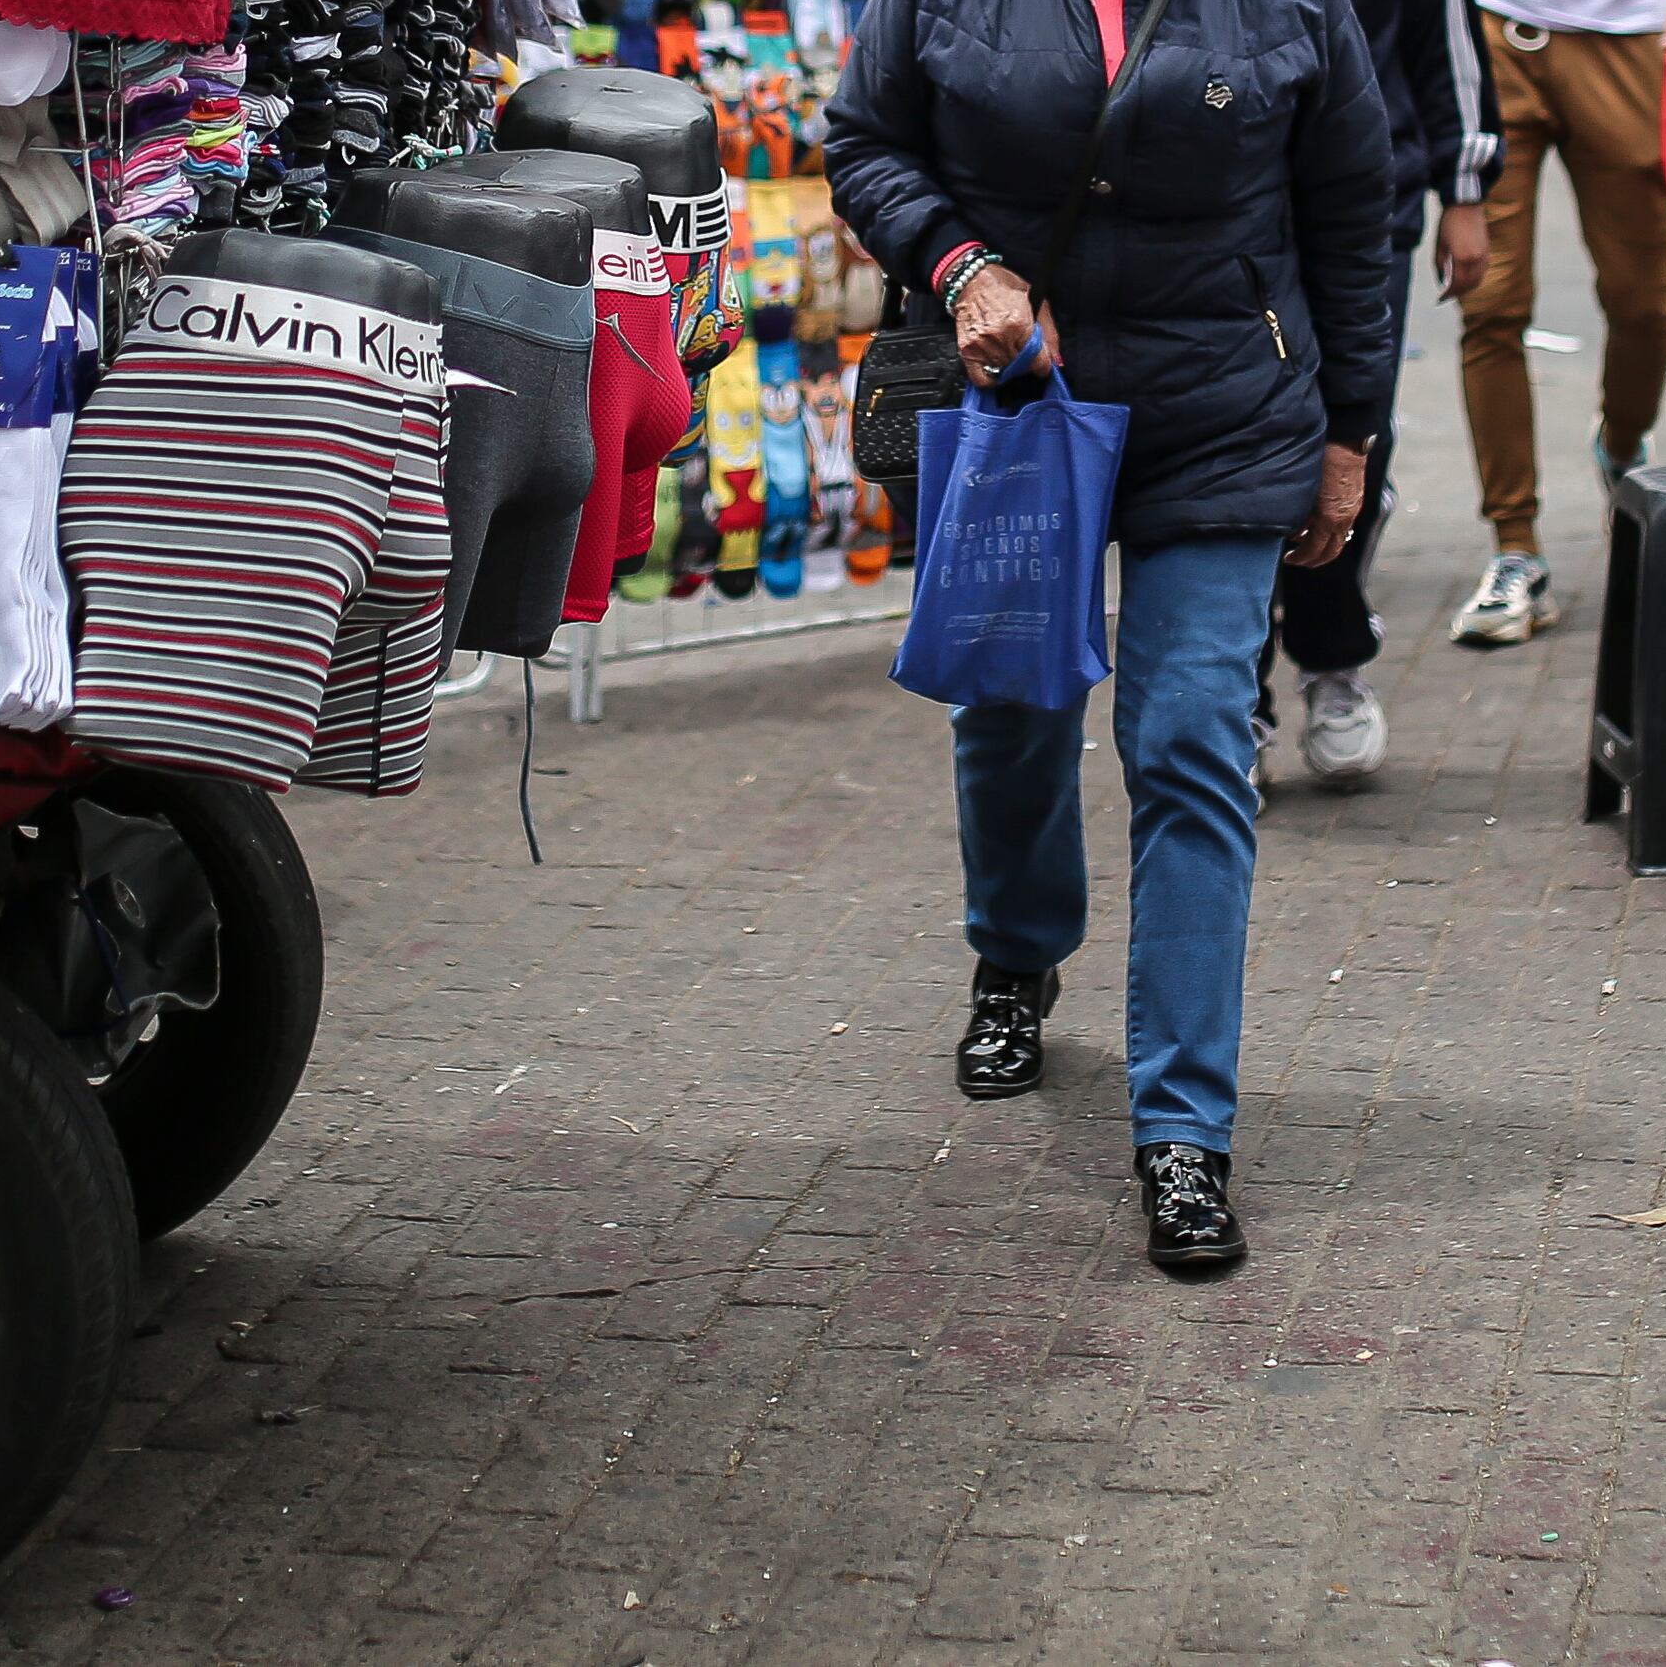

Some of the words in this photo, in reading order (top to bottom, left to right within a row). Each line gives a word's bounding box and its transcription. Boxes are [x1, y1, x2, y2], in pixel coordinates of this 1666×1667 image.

[597, 245, 648, 282] ein
[145, 284, 342, 359] Calvin
[357, 316, 444, 381] Klein
